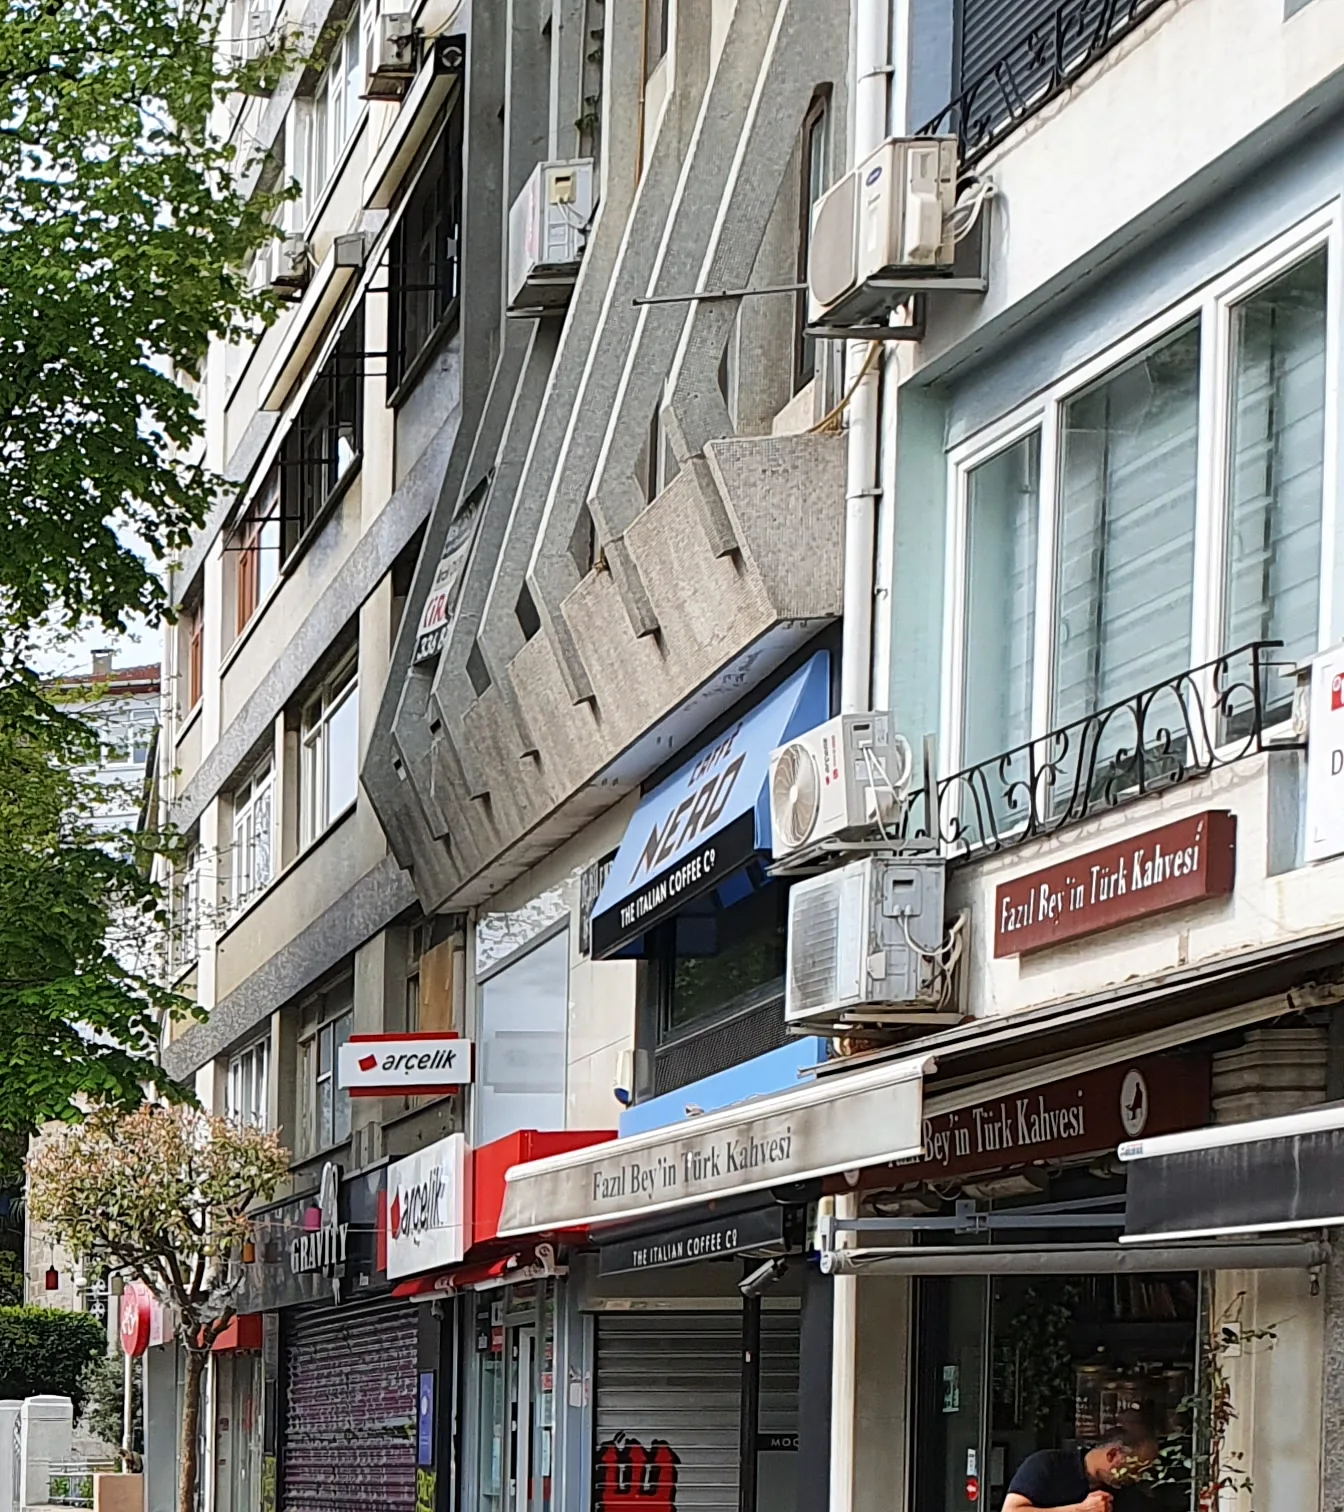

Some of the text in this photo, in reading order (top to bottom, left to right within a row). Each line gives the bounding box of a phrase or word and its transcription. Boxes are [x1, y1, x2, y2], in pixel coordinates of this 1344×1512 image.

[629, 751, 747, 886] NERO
[621, 902, 635, 928] THE
[636, 882, 668, 917] ITALIAN
[669, 856, 702, 896] COFFEE
[1001, 888, 1035, 934] Fazıl
[1090, 856, 1127, 905] Türk
[1130, 835, 1201, 892] Kahvesi
[382, 1049, 456, 1075] arçelik
[972, 1103, 1012, 1153] Türk
[1015, 1089, 1085, 1146] Kahvesi
[593, 1166, 625, 1200] Fazıl
[680, 1146, 721, 1183] Türk
[726, 1129, 792, 1173] Kahvesi
[291, 1222, 349, 1273] GRAVITY
[633, 1249, 648, 1266] THE
[650, 1241, 683, 1263] ITALIAN
[687, 1231, 722, 1256] COFFEE
